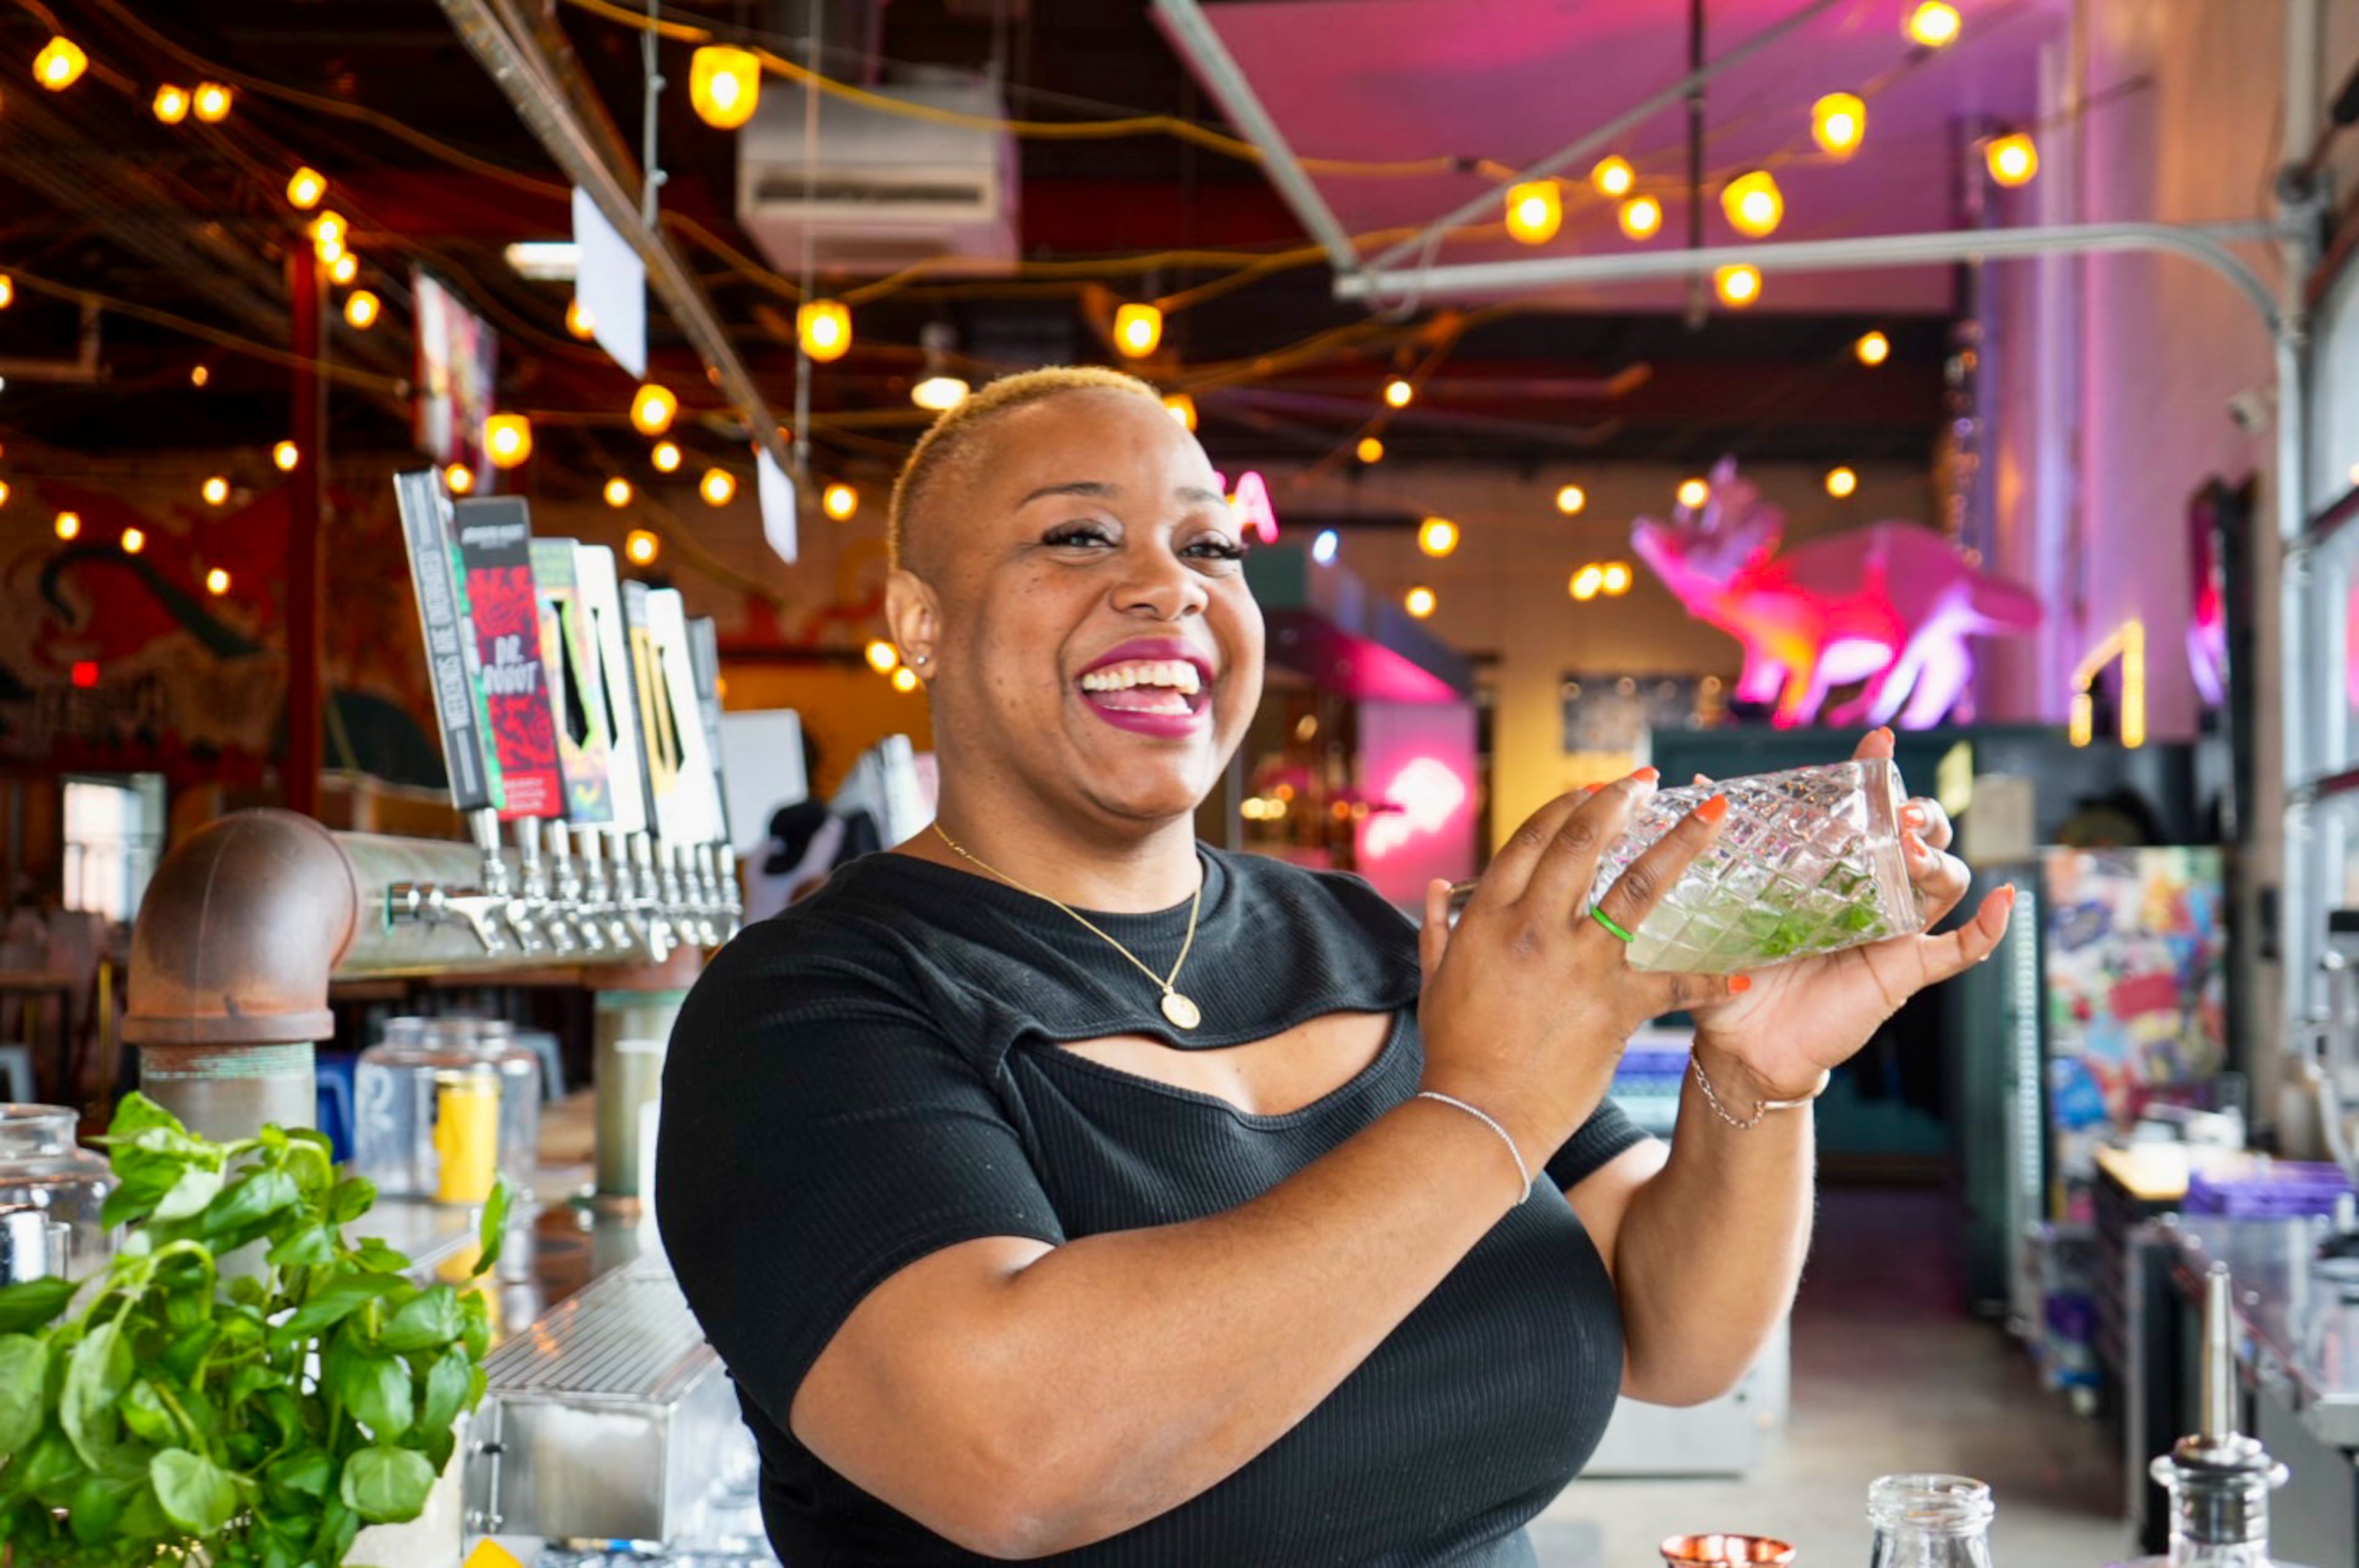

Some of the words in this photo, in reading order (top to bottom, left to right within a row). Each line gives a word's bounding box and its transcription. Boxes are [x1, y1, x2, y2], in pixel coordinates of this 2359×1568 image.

[431, 625, 458, 655] ARE
[437, 654, 471, 731] WEEKENDS
[483, 661, 538, 695] ROBOT
